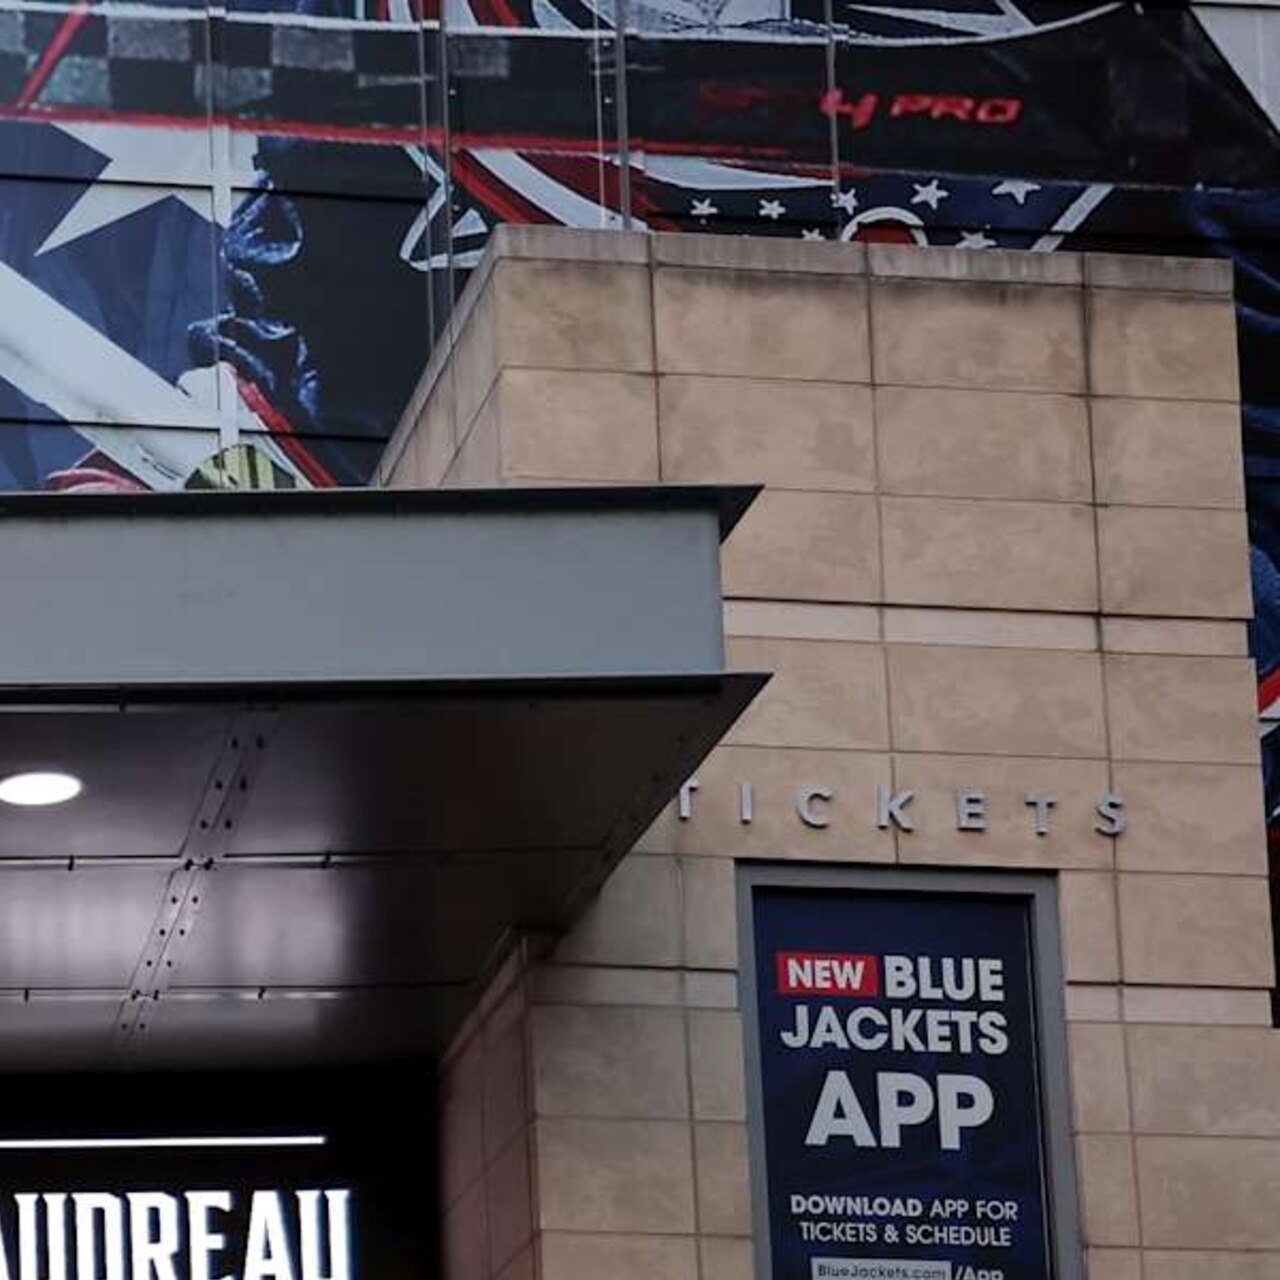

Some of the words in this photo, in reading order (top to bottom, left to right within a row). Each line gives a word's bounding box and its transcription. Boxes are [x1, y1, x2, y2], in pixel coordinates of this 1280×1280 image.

[890, 93, 1023, 124] PRO
[678, 780, 1128, 838] TICKETS
[786, 959, 863, 991] NEW
[884, 955, 1005, 1001] BLUE
[780, 1006, 1008, 1056] JACKETS
[803, 1070, 995, 1151] APP
[789, 1194, 923, 1218] DOWNLOAD
[929, 1198, 969, 1219] APP
[976, 1200, 1019, 1221] FOR
[799, 1222, 878, 1243] TICKETS
[883, 1223, 900, 1244] &
[905, 1224, 1012, 1247] SCHEDULE
